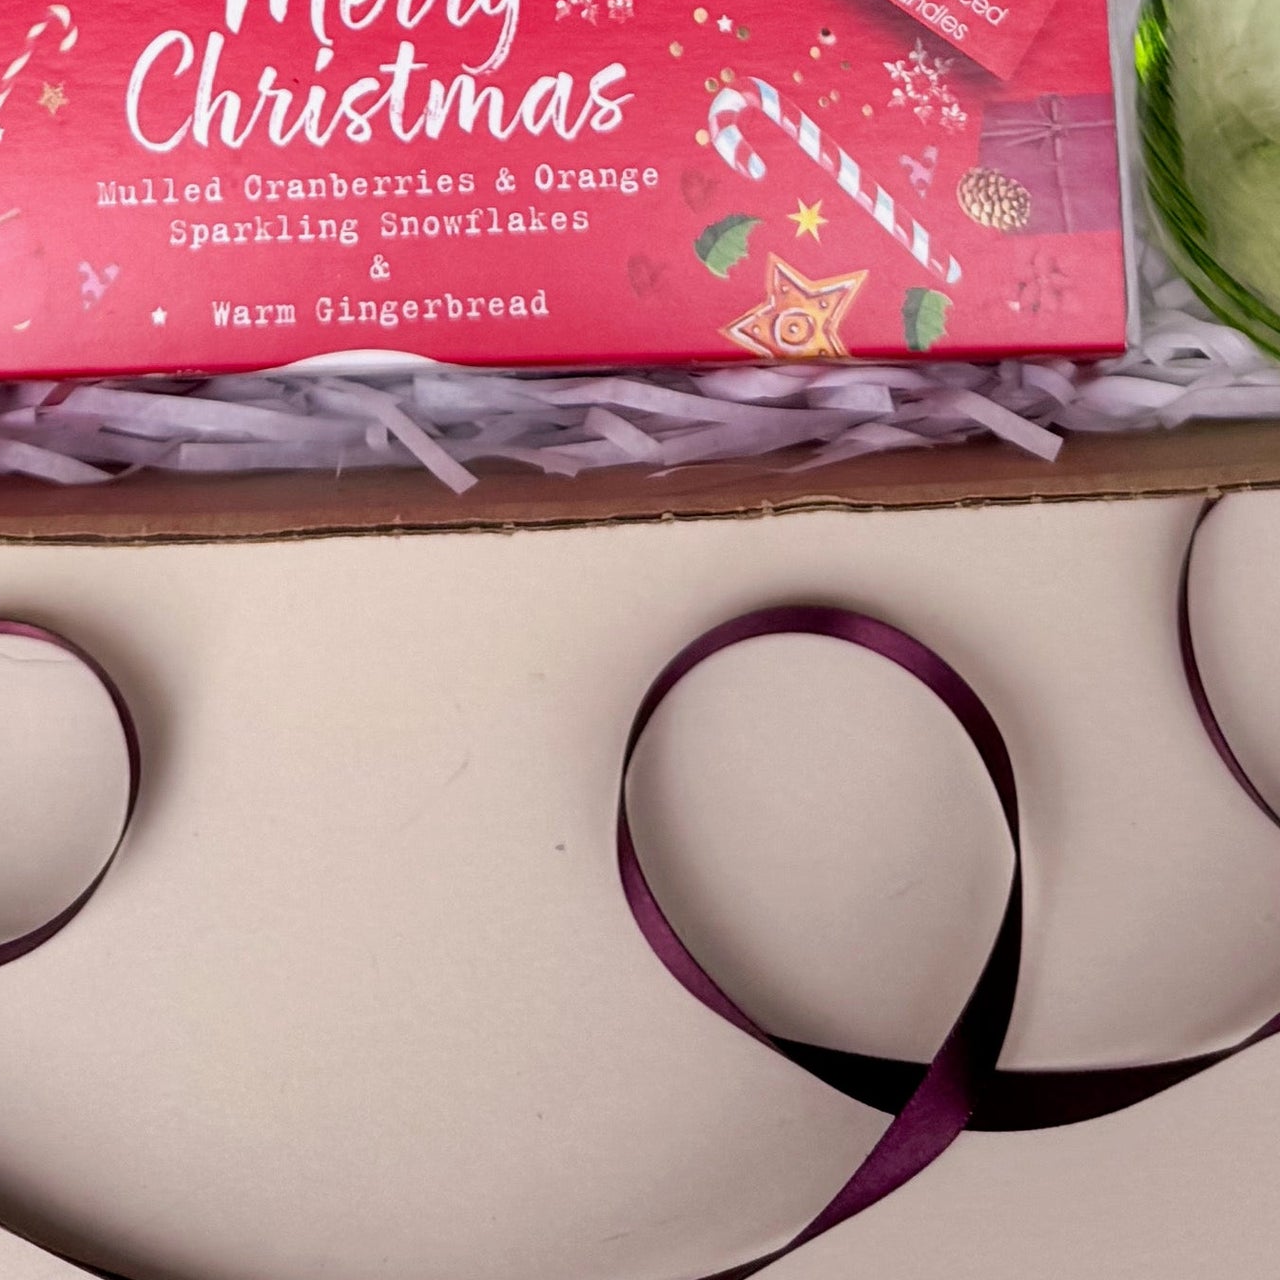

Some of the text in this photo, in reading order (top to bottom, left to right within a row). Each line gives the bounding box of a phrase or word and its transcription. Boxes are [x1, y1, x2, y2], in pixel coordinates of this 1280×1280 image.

[126, 30, 635, 153] Christmas
[96, 162, 660, 207] Mulled Cranberries & Orange
[169, 206, 590, 251] Sparkling Snowflakes
[368, 255, 391, 280] &
[212, 289, 549, 328] Warm Gingerbread
